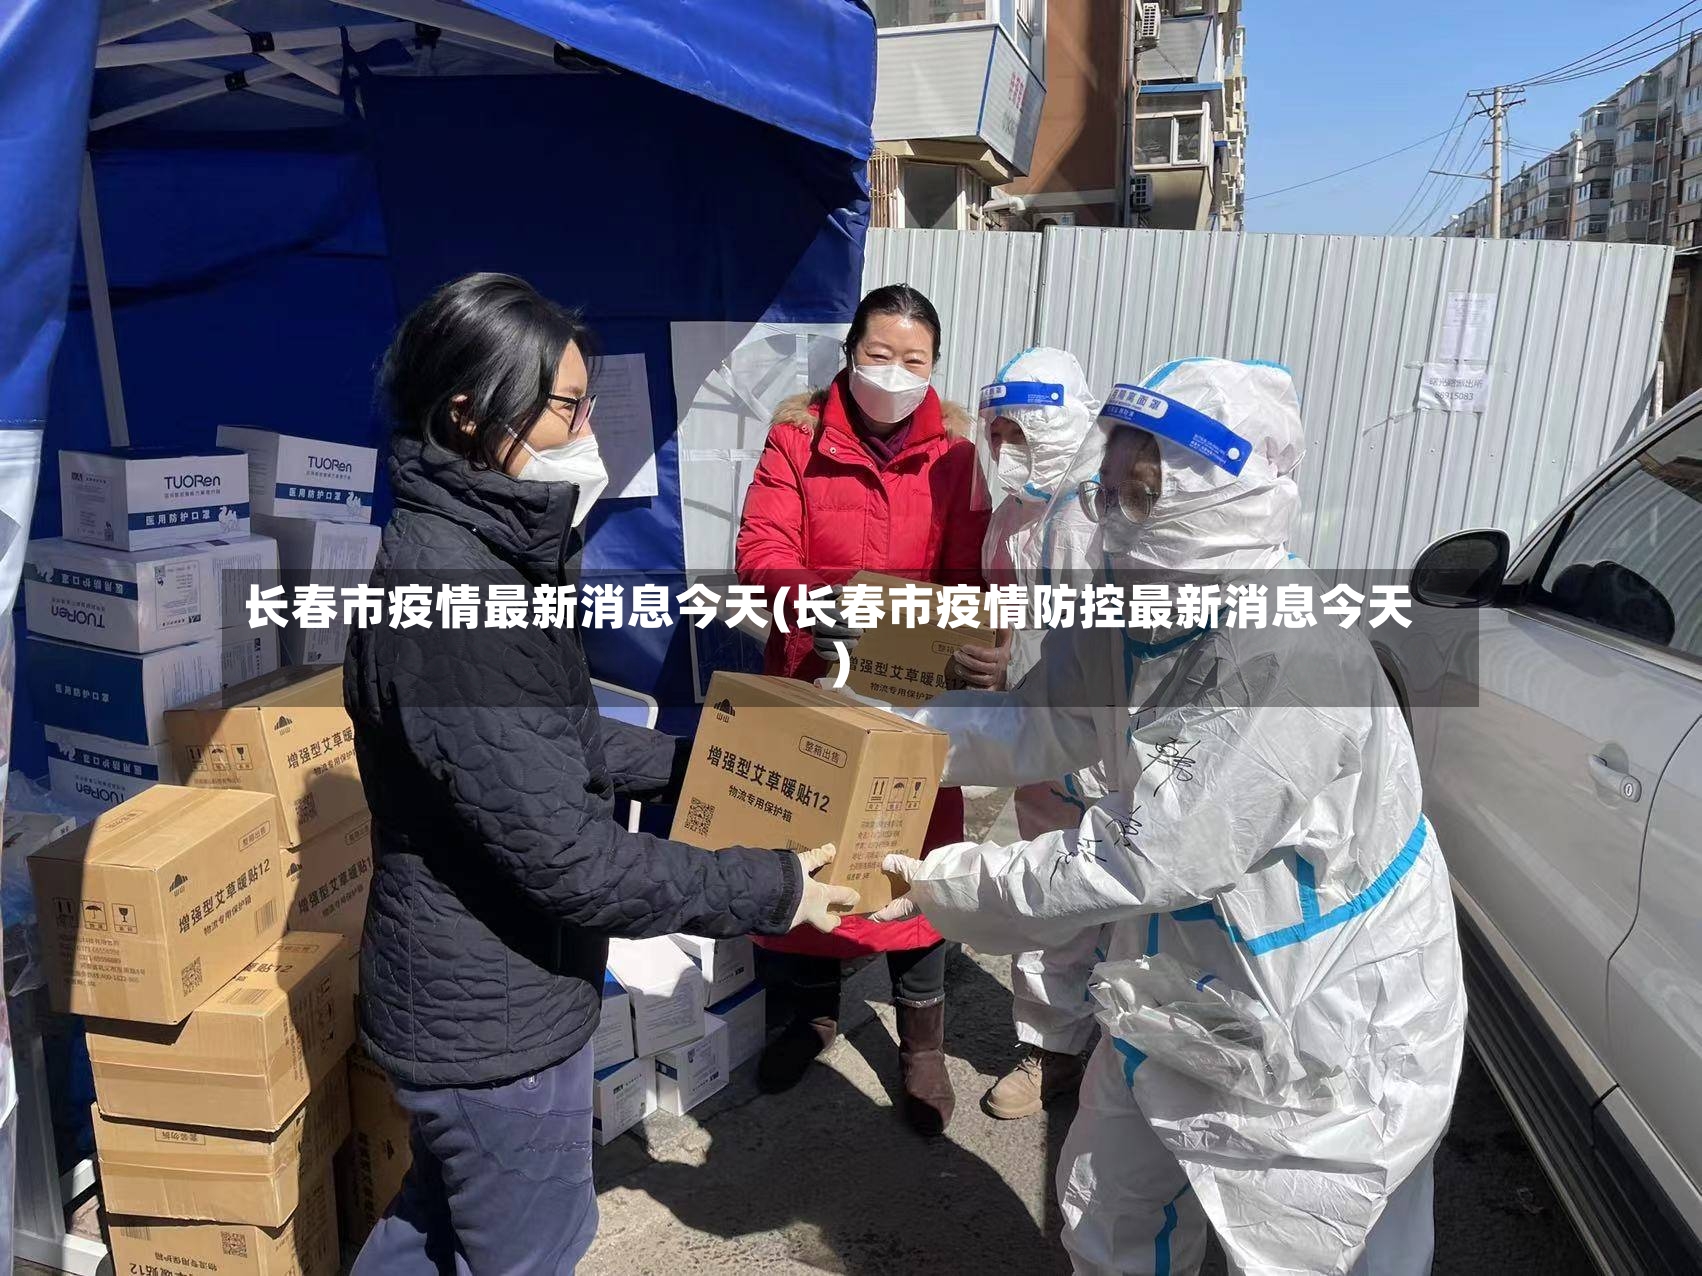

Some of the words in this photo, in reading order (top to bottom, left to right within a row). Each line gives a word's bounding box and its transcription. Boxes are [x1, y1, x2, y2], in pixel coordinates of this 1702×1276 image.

[307, 456, 352, 473] TUORen
[164, 474, 221, 490] TUORen
[288, 487, 342, 501] 医用防护口罩
[145, 509, 211, 526] 医用防护口罩
[61, 574, 124, 595] 医用防护口罩
[51, 605, 106, 629] TUORen
[54, 683, 112, 703] 医用防护口罩
[313, 749, 357, 776] 物流专用保护
[804, 740, 840, 764] 整箱出售
[83, 755, 142, 776] 医用防护口罩
[706, 744, 831, 813] 增强型艾草暖贴12
[728, 785, 793, 822] 物流专用保护箱
[178, 858, 271, 934] 增强型艾草暖贴12
[203, 895, 252, 936] 物流专用保护箱
[154, 1251, 218, 1272] 物流专用保护箱
